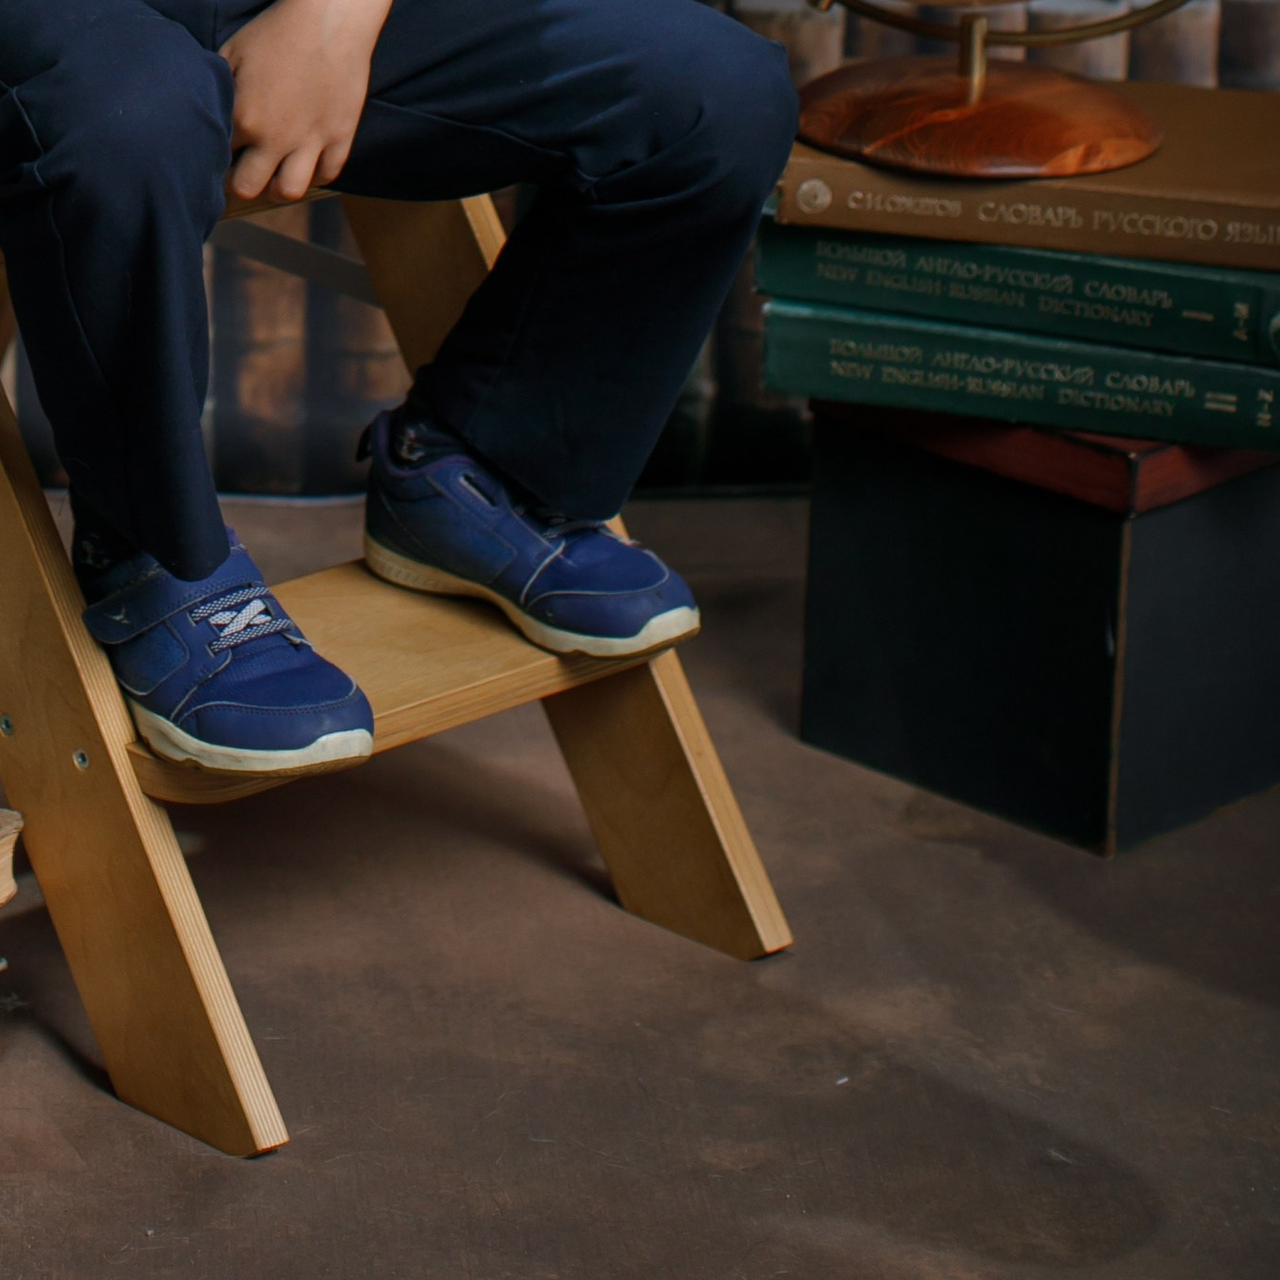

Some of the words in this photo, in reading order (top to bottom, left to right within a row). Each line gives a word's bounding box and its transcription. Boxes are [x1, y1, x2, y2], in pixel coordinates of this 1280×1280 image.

[977, 201, 1083, 228] СЛОВАРЬ
[1092, 210, 1218, 240] РУССКОГО
[1224, 221, 1280, 245] ЯЗЫ
[916, 255, 1074, 294] АНГЛО-РУССКИЙ
[1083, 280, 1173, 309] СЛОВАРЬ
[1038, 295, 1155, 327] DICTIONARY
[930, 351, 1094, 387] АНГЛО-РУССКИЙ
[1105, 371, 1196, 398] СЛОВАРЬ
[1058, 389, 1176, 416] DICTIONARY
